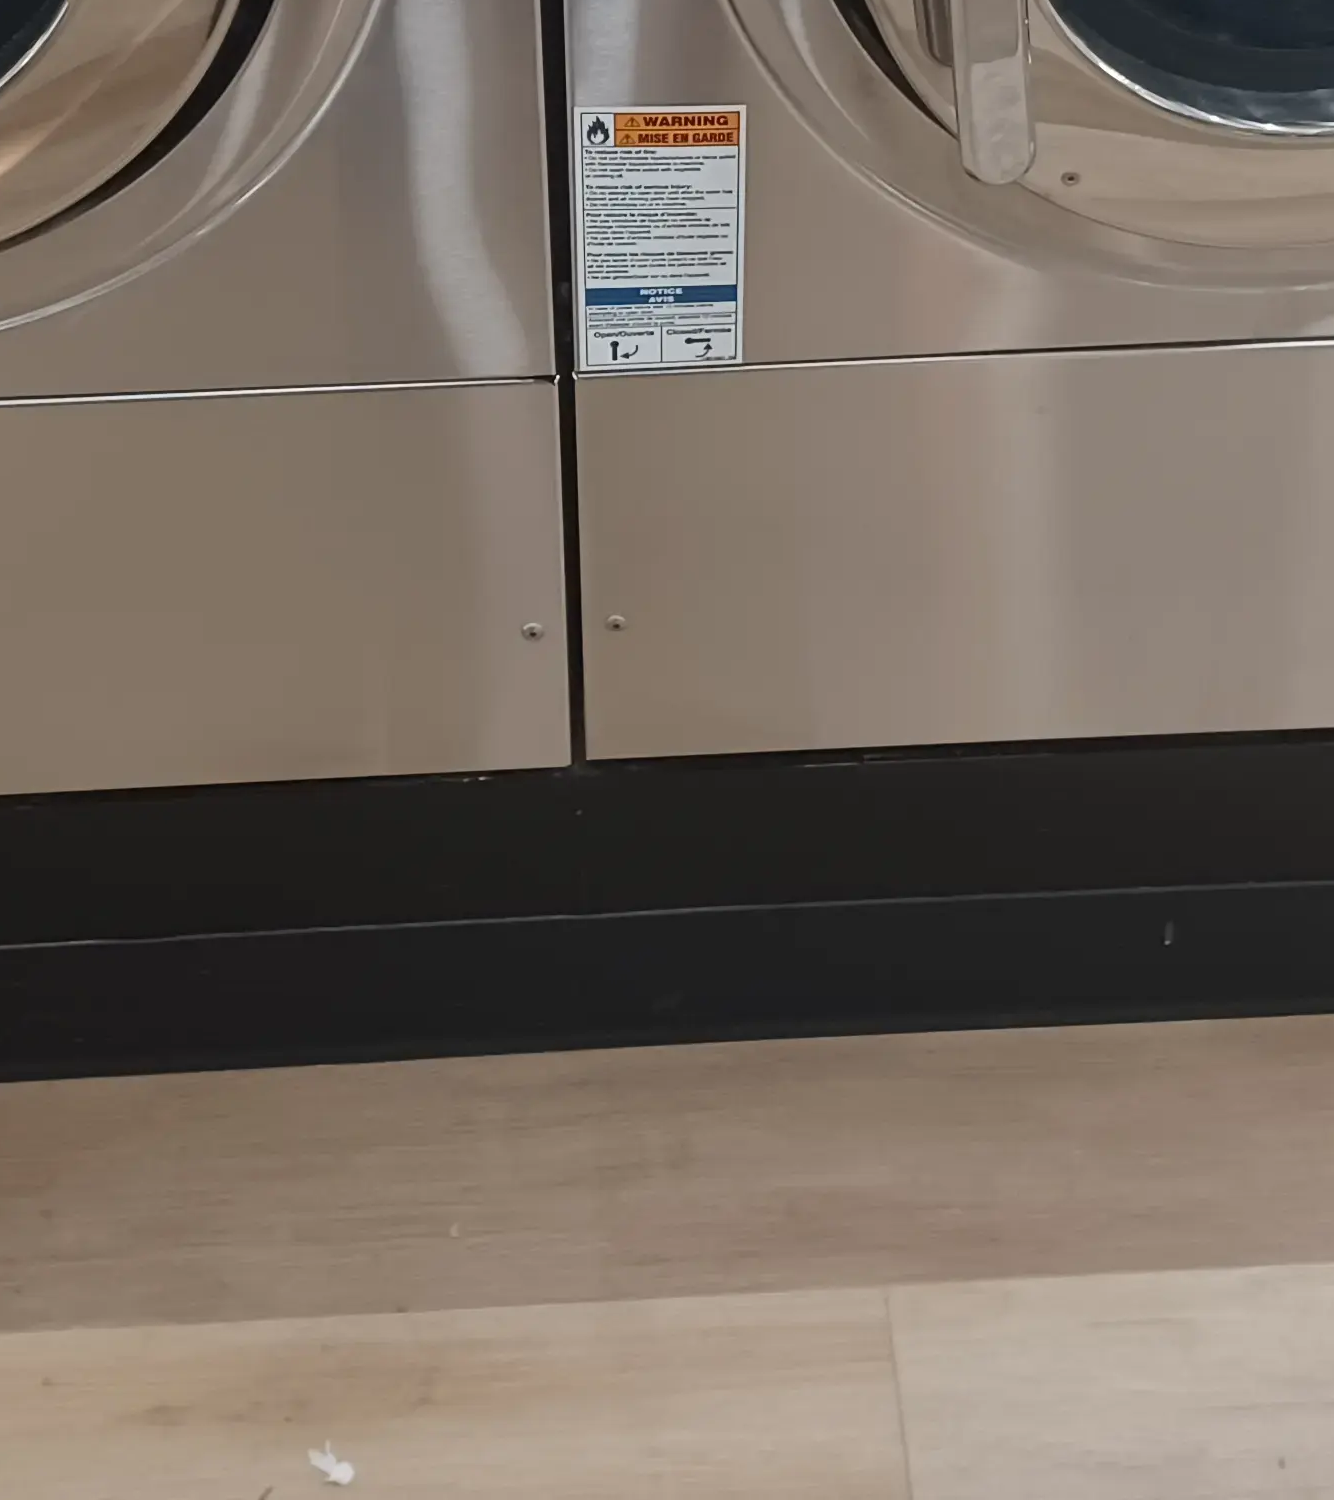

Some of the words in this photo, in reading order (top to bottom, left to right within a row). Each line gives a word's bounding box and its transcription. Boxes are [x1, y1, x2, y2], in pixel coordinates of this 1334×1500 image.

[642, 115, 729, 128] WARNING
[637, 133, 669, 144] MISE
[672, 132, 689, 143] EN
[692, 132, 734, 144] GARDE
[639, 287, 683, 296] NOTICE
